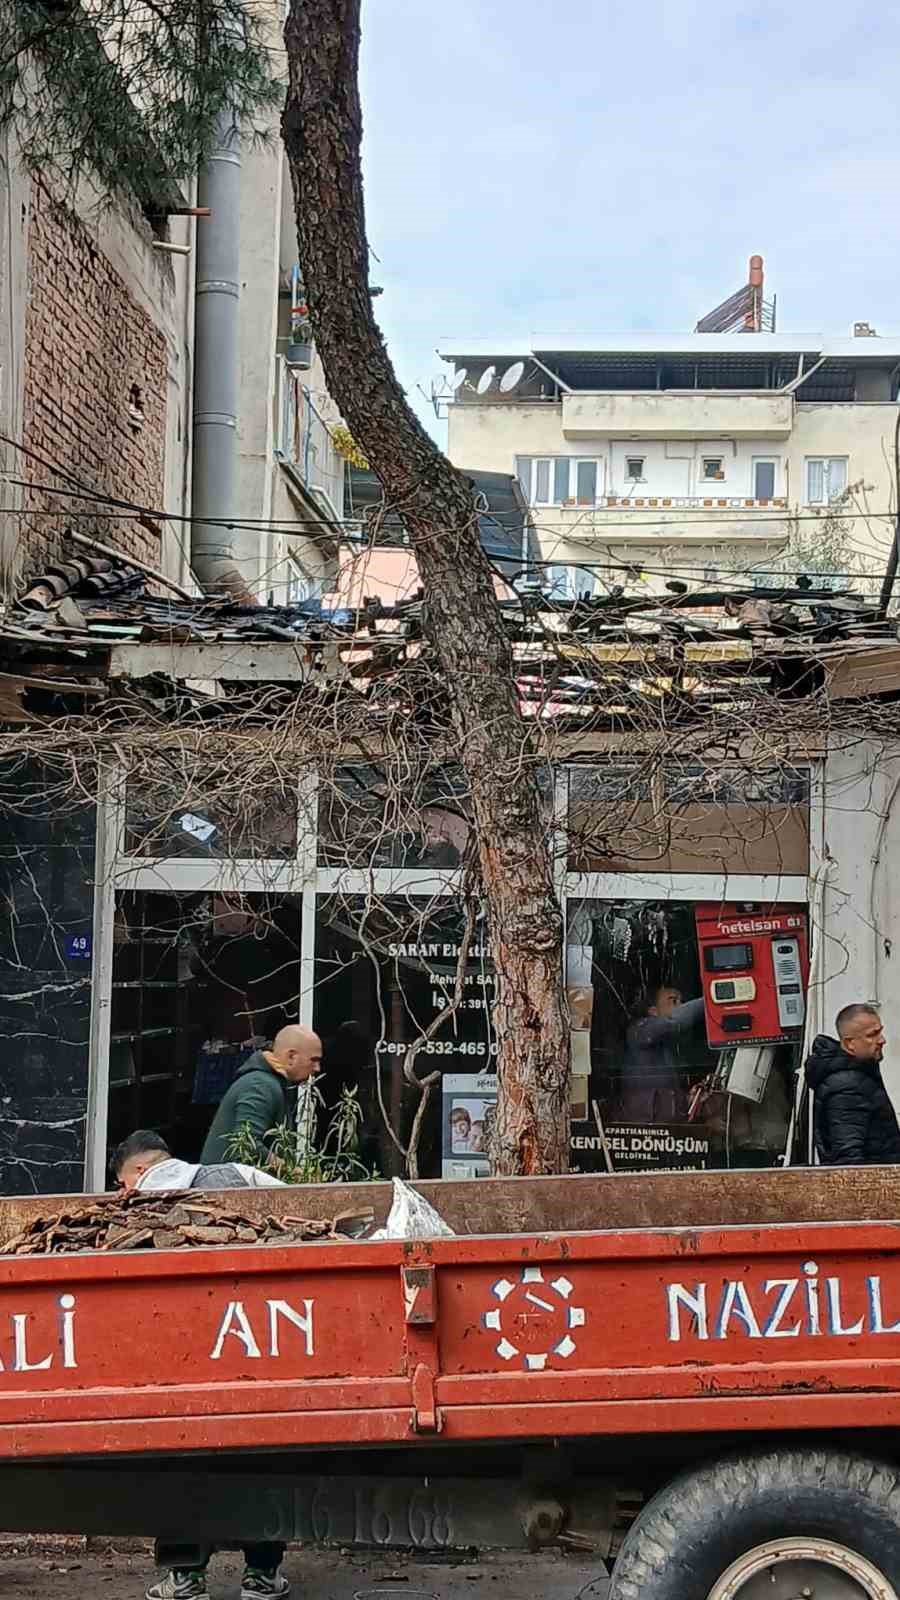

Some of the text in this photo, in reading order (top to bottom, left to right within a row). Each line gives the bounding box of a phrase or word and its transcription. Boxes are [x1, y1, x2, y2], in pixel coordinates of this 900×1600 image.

[721, 919, 780, 934] netelsan
[73, 937, 86, 949] 49
[388, 943, 438, 957] SARAN
[430, 974, 473, 985] Mehet
[631, 1136, 709, 1155] DÖNÜŞÜM
[0, 1294, 79, 1371] Lİ
[208, 1299, 315, 1359] AN
